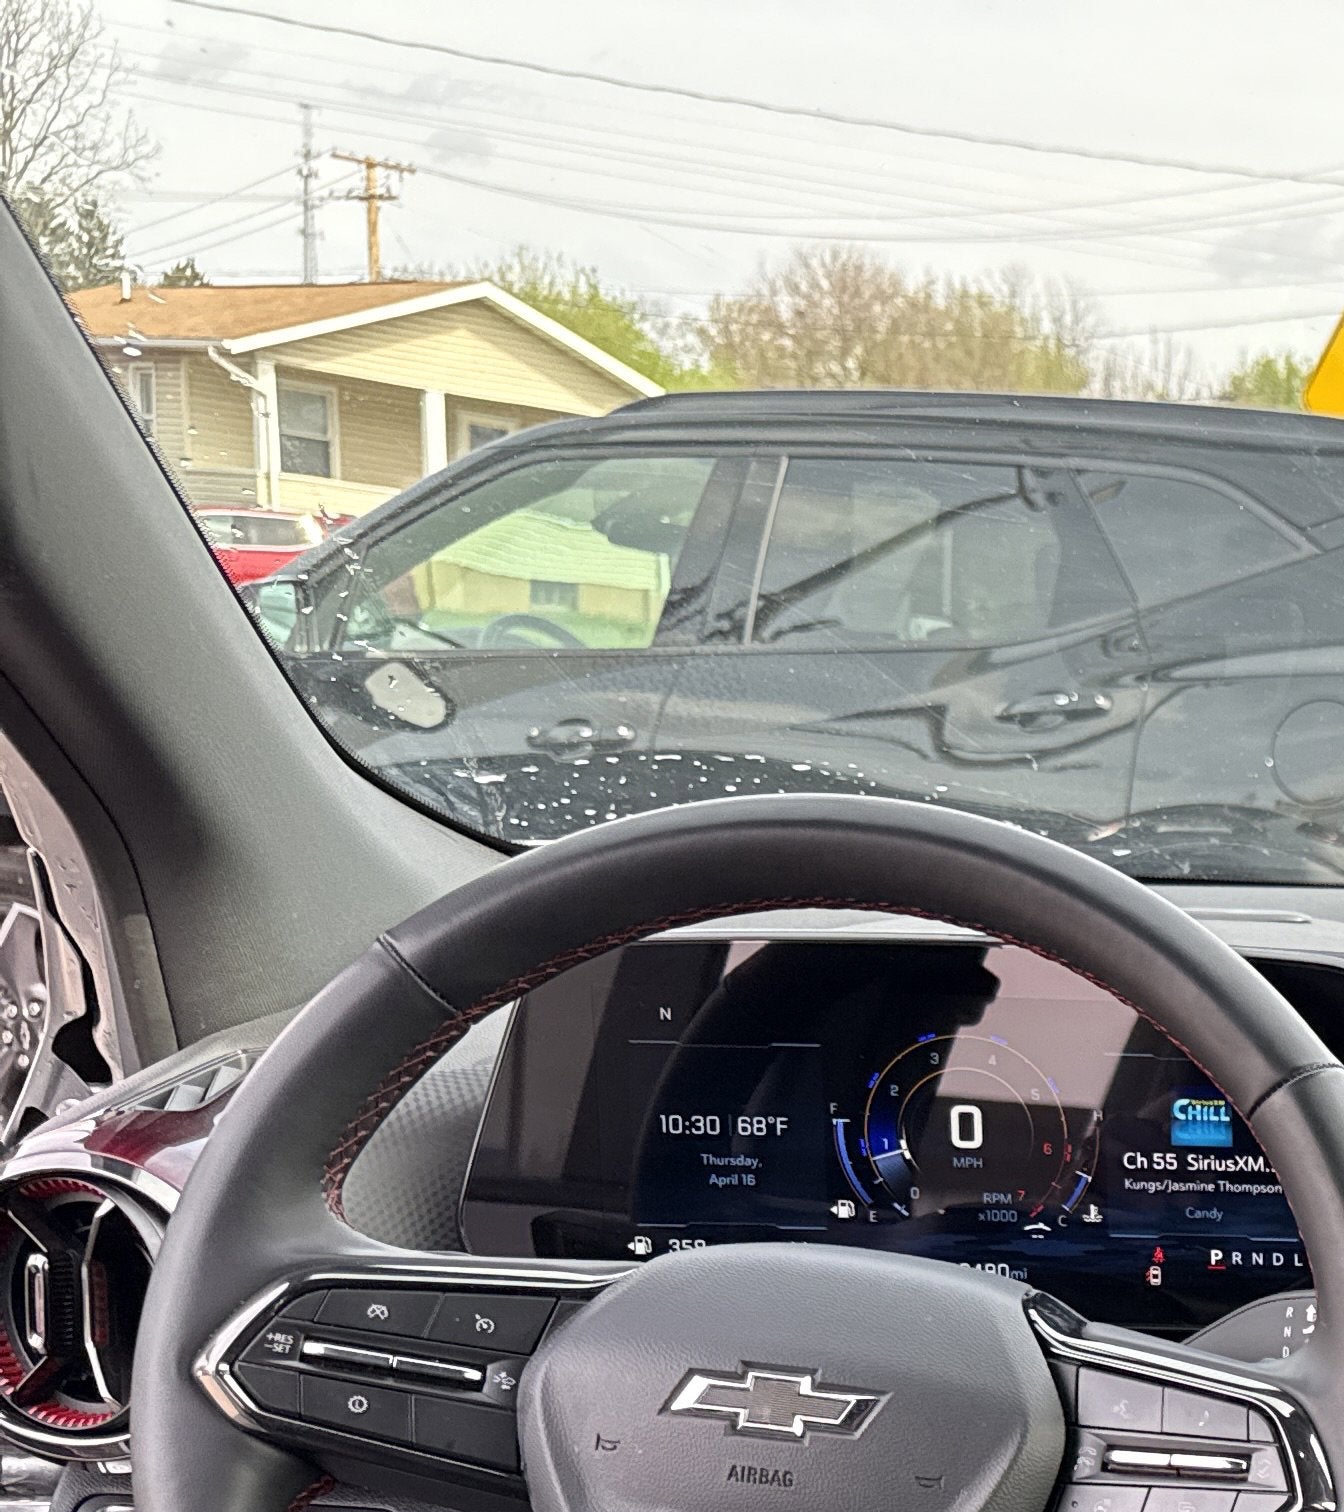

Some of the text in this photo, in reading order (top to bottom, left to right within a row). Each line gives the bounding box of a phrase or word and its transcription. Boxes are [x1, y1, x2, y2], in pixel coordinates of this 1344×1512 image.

[659, 1007, 672, 1021] N
[930, 1053, 939, 1065] 3
[988, 1055, 997, 1067] 4
[890, 1085, 899, 1097] 2
[830, 1103, 839, 1115] F
[660, 1114, 789, 1136] 10:30 68°F
[950, 1104, 983, 1149] 0
[1043, 1143, 1052, 1155] 6
[700, 1153, 763, 1169] Thursday,
[953, 1157, 983, 1169] MPH
[1123, 1152, 1148, 1170] Ch
[1153, 1153, 1178, 1170] 55
[709, 1174, 756, 1188] April 16
[1124, 1178, 1283, 1195] Kungs/Jasmine Thompson
[910, 1187, 920, 1199] 0
[983, 1193, 1012, 1205] RPM
[978, 1210, 1018, 1223] x1000
[1185, 1206, 1224, 1221] Candy
[1211, 1250, 1304, 1267] P R N D L
[1286, 1306, 1294, 1318] R
[1283, 1326, 1292, 1338] N
[727, 1464, 794, 1487] AIRBAG
